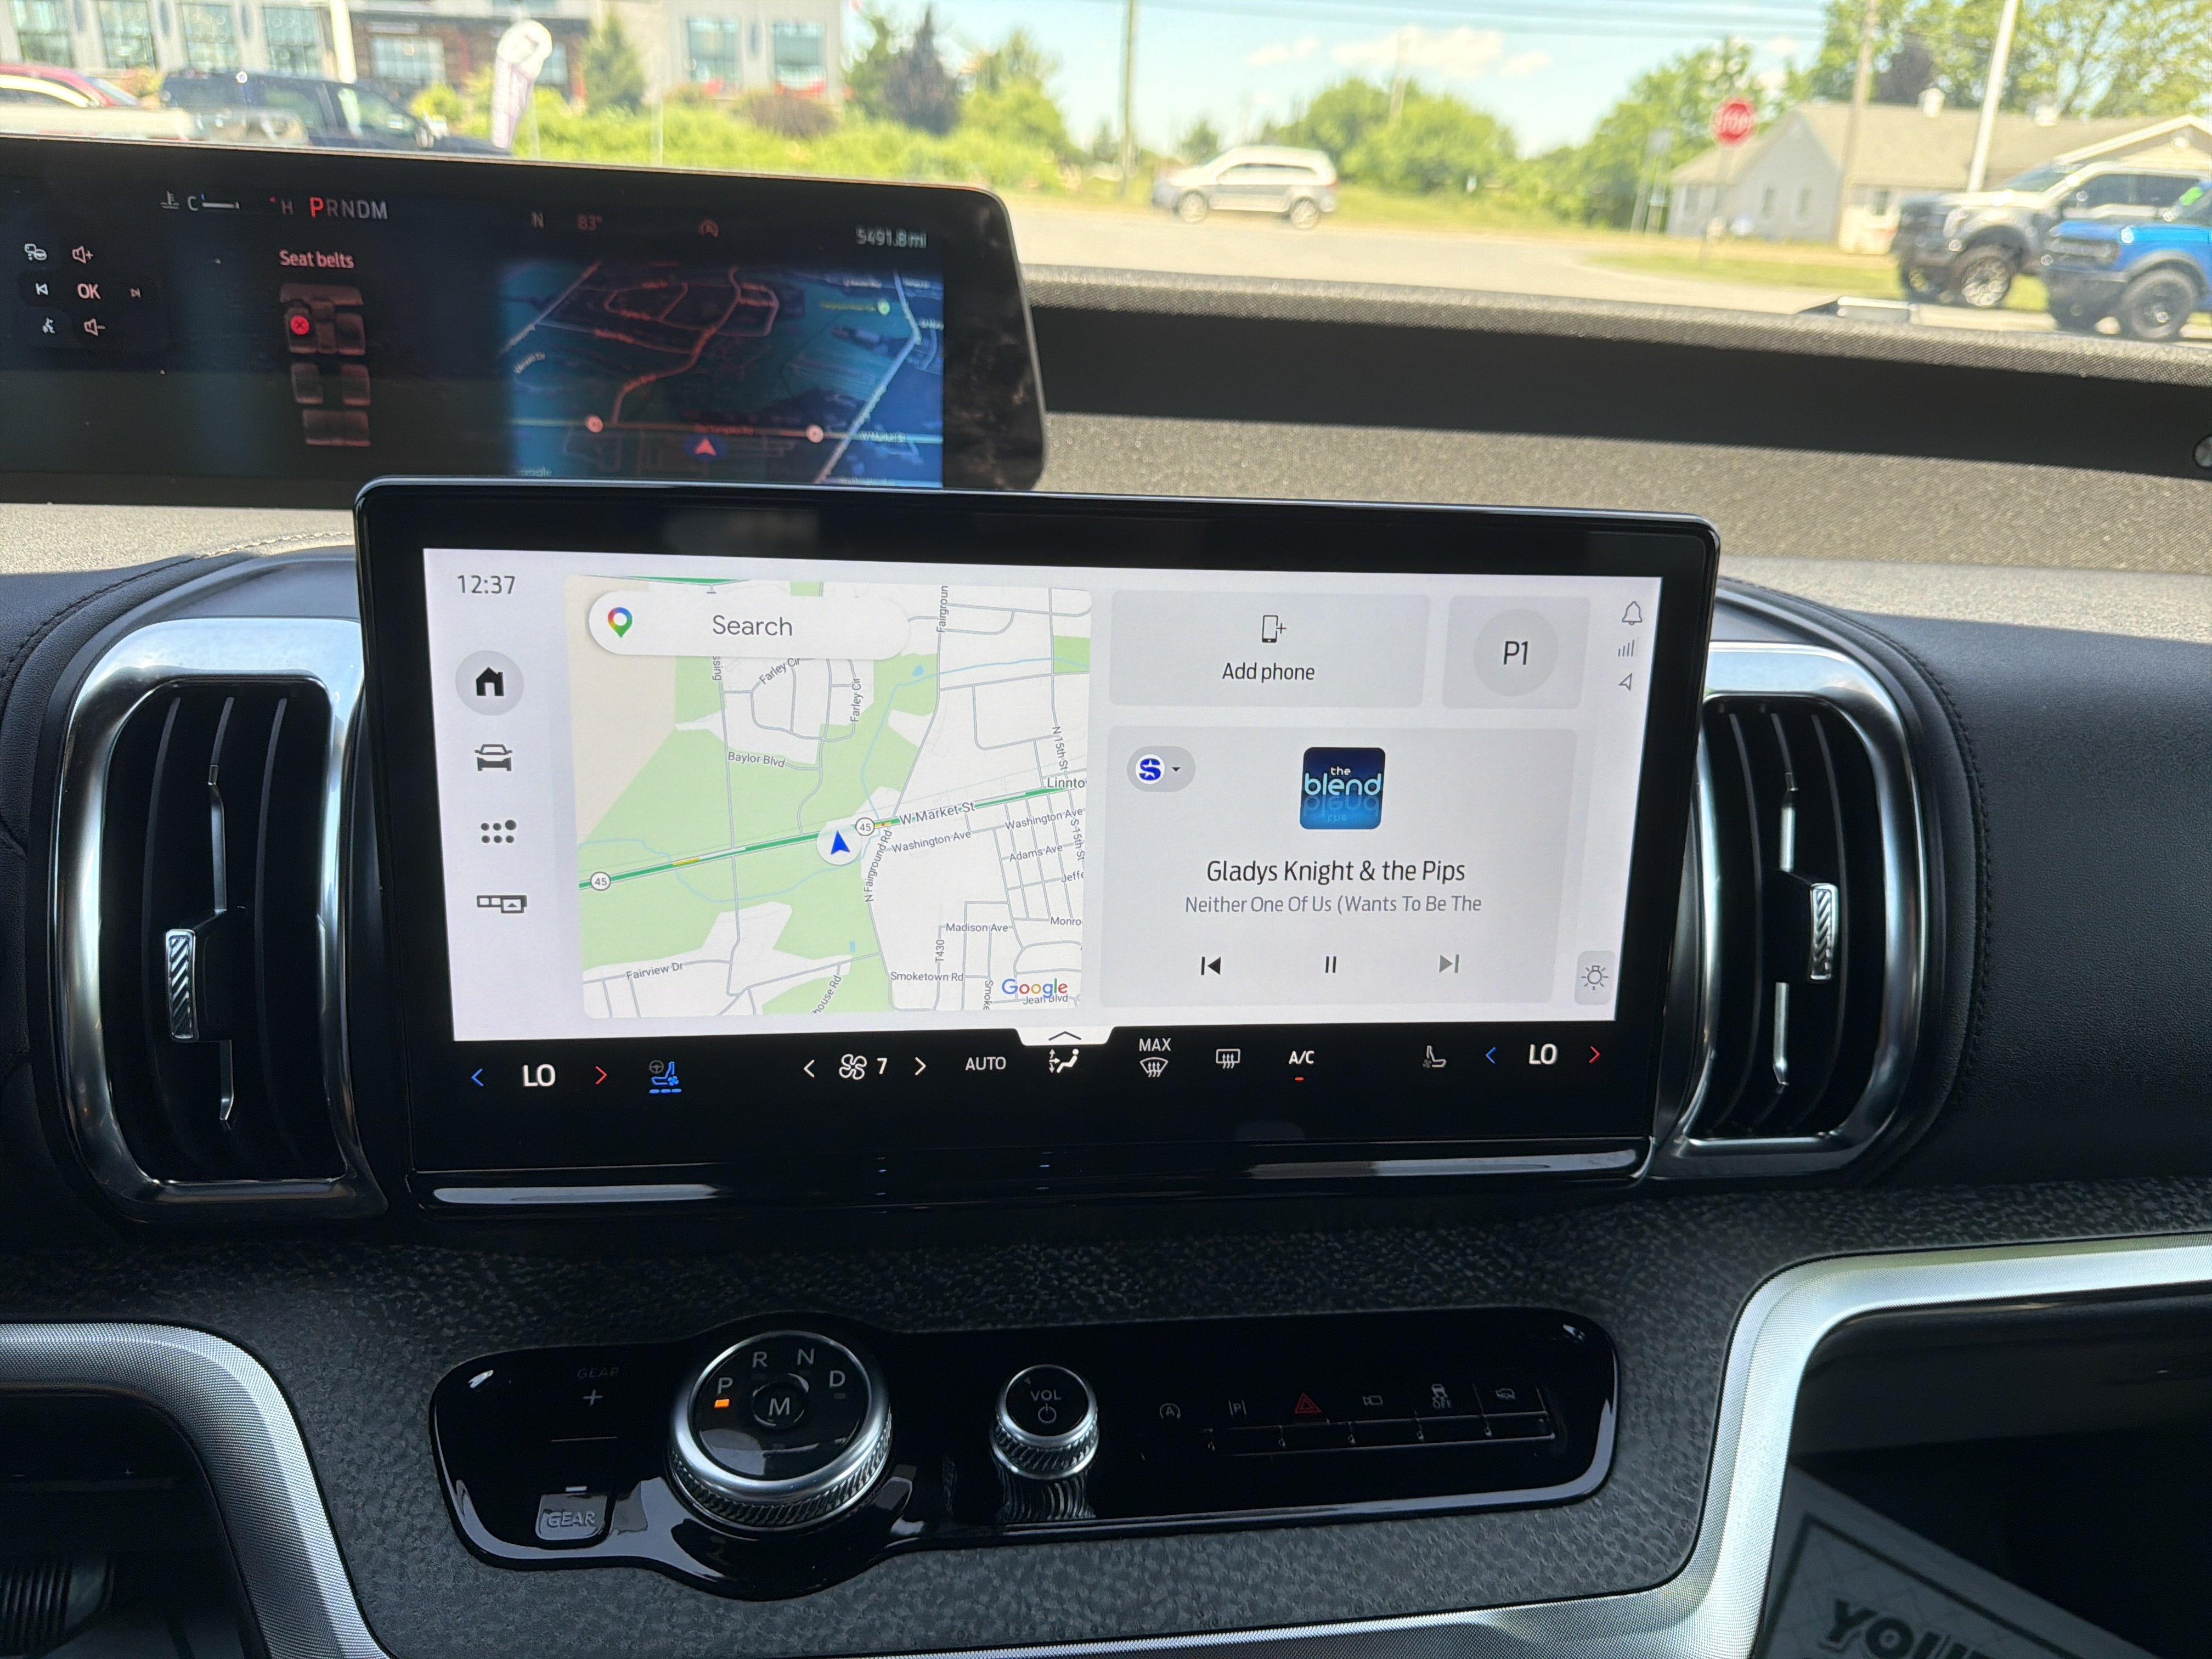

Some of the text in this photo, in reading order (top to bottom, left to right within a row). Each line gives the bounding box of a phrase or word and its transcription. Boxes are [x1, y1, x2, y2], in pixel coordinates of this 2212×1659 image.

[279, 249, 354, 269] Seat belts
[77, 283, 101, 300] OK
[457, 575, 516, 595] 12:37
[936, 585, 949, 633] Fairgroun
[712, 614, 793, 637] Search
[1503, 641, 1529, 665] P1
[759, 658, 801, 685] Farley Cir
[1222, 662, 1316, 684] Add phone
[850, 677, 864, 722] Farley Cir
[1052, 726, 1068, 771] N 15th St
[728, 752, 786, 768] Baylor Blvd
[1330, 766, 1351, 775] the
[1047, 777, 1087, 788] Linnto
[1305, 773, 1381, 795] blend
[900, 802, 975, 825] W Market St
[1005, 808, 1083, 830] Washington Ave
[859, 823, 871, 832] 45
[891, 832, 972, 853] Washington Ave
[1073, 828, 1082, 849] 15th
[864, 843, 887, 892] Fairground
[883, 830, 892, 843] Rd
[1009, 845, 1063, 862] Adams Ave
[1077, 851, 1085, 861] St
[594, 878, 607, 886] 45
[1207, 860, 1465, 885] Gladys Knight & the Pips
[1185, 895, 1481, 915] Neither One Of Us (Wants To Be The
[946, 923, 1008, 932] Madison Ave
[1050, 917, 1084, 926] Monro
[935, 939, 945, 963] T430
[626, 962, 684, 980] Fairview Dr
[890, 972, 963, 981] Smoketown Rd
[811, 974, 842, 1014] house Rd
[983, 980, 994, 1011] Smoke
[1002, 978, 1068, 998] Google
[1139, 1039, 1171, 1052] MAX
[1529, 1043, 1557, 1065] LO
[877, 1058, 888, 1075] 7
[966, 1057, 1006, 1071] AUTO
[1289, 1051, 1314, 1064] A/C
[522, 1064, 556, 1087] LO
[752, 1351, 768, 1368] R
[797, 1348, 815, 1365] N
[717, 1377, 733, 1394] P
[830, 1370, 846, 1387] D
[1030, 1390, 1062, 1401] VOL
[769, 1397, 790, 1416] M
[546, 1510, 596, 1528] GEAR
